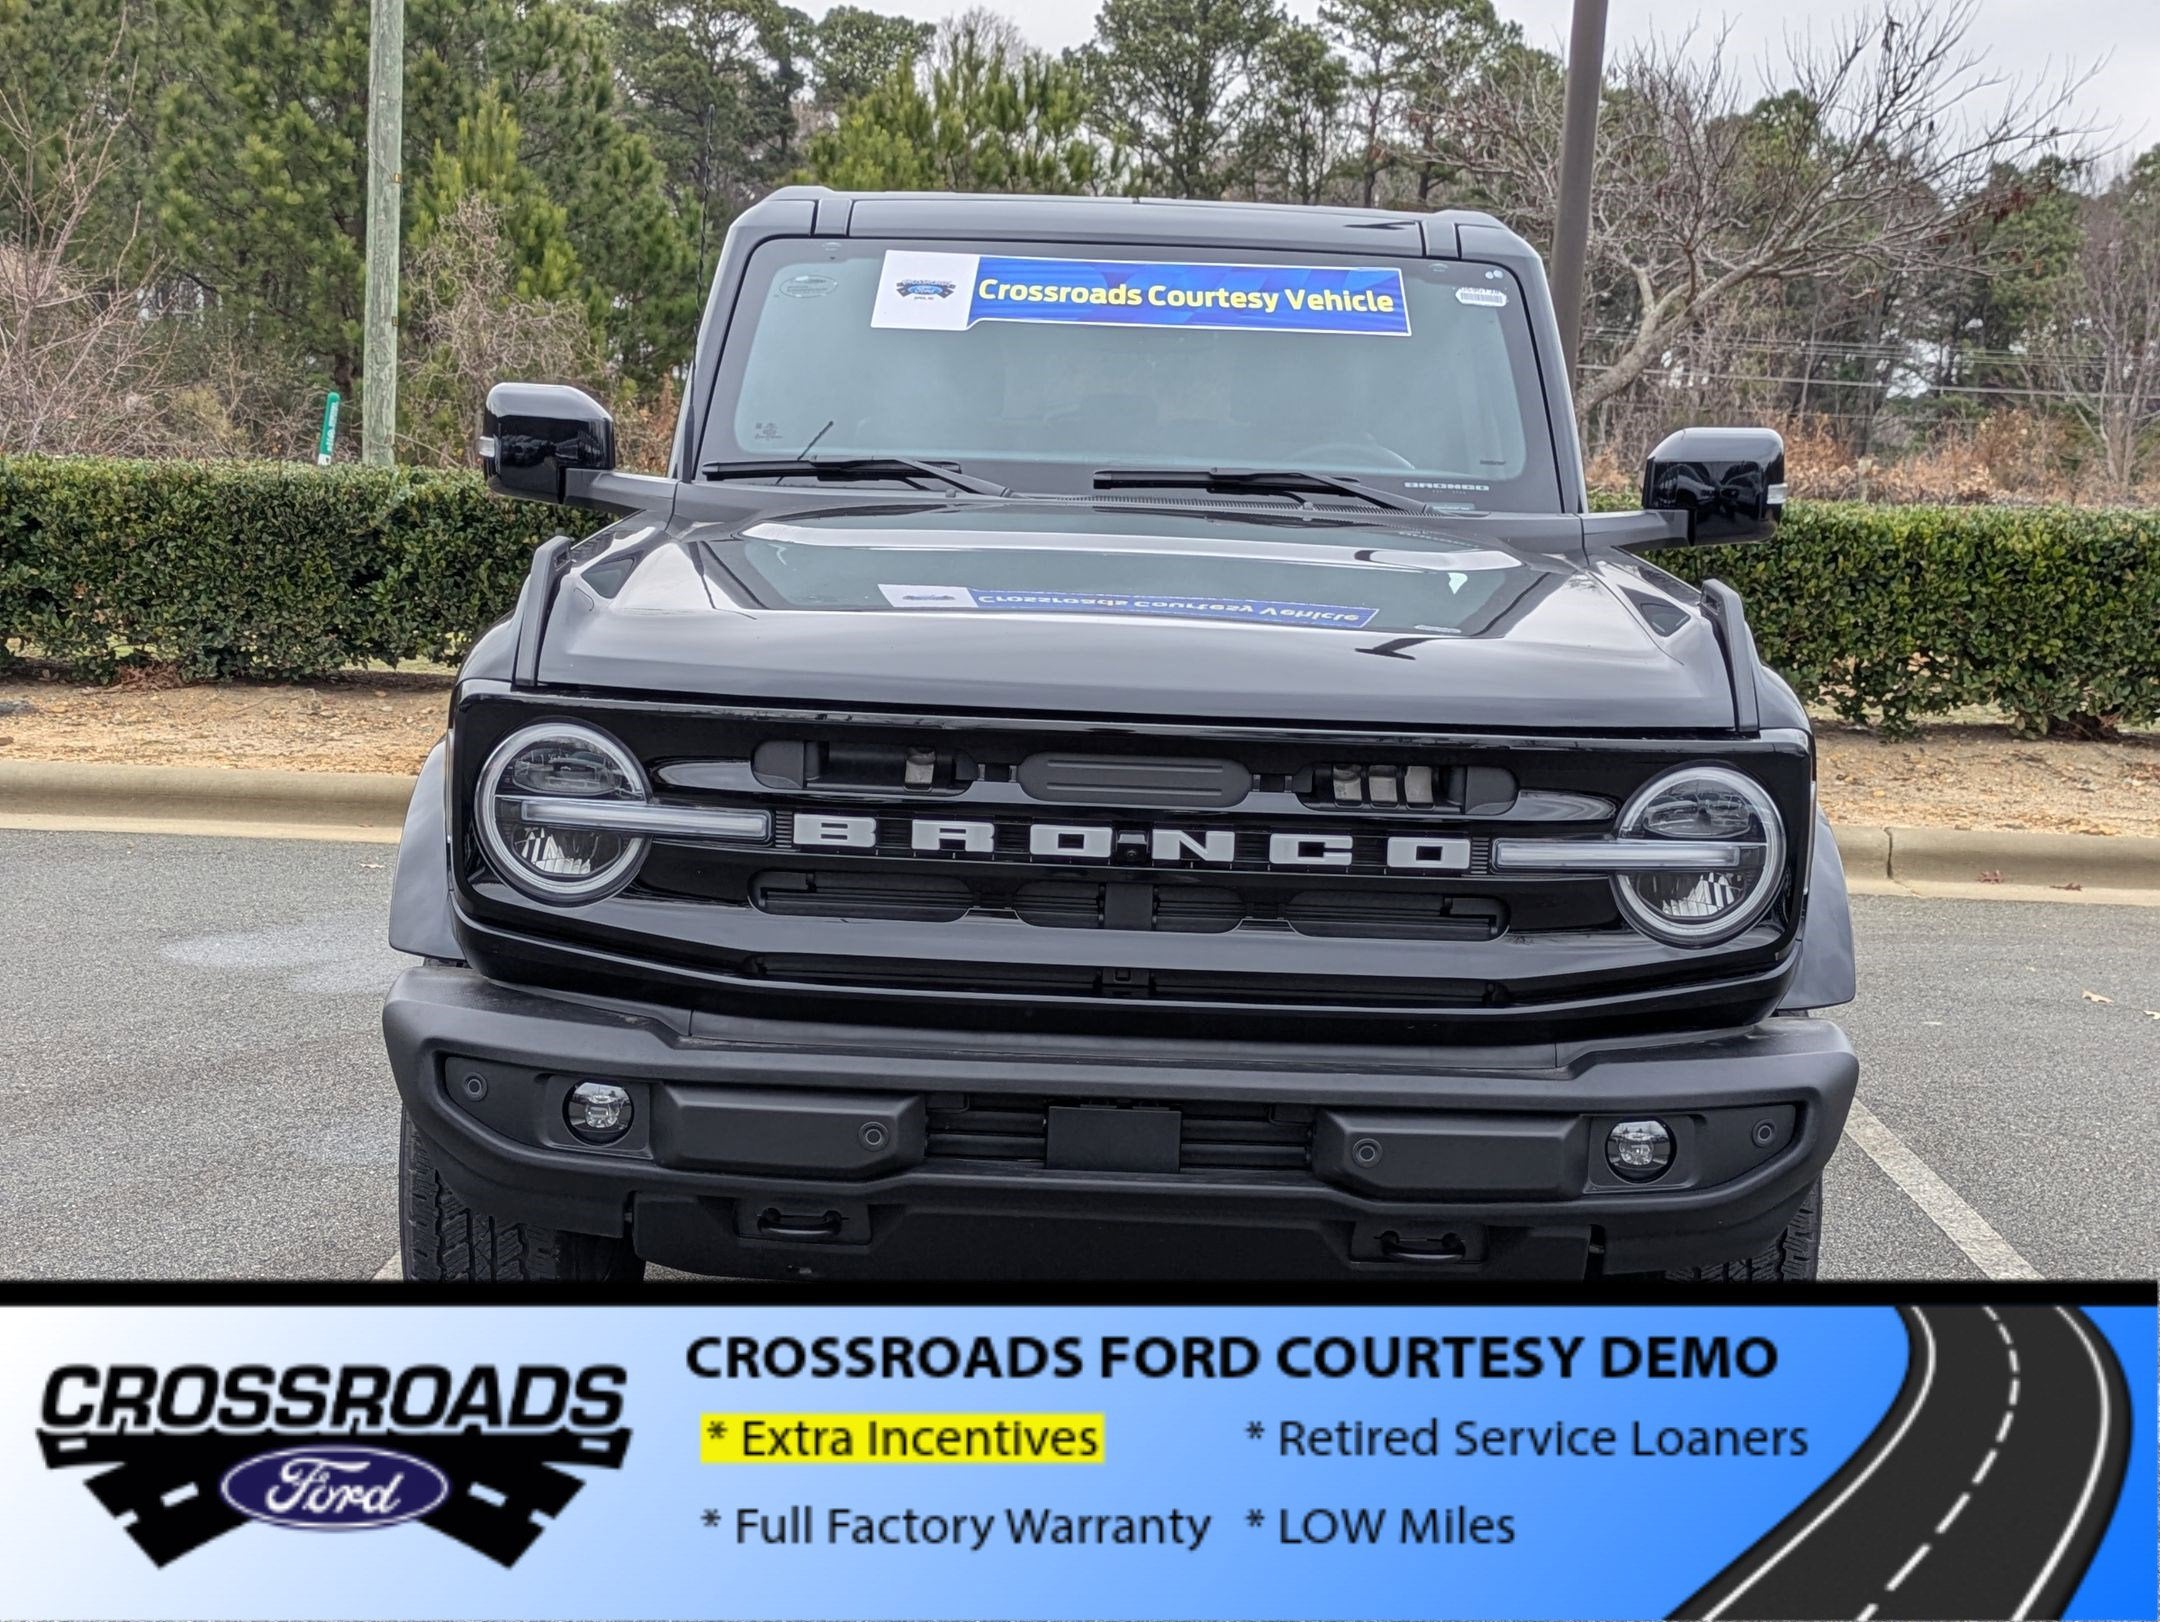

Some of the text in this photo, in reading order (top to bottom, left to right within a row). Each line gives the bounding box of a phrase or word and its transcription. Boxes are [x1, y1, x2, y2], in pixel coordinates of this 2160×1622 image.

[979, 279, 1394, 313] Crossroads Courtesy Vehicle
[793, 812, 1471, 869] BRONCO
